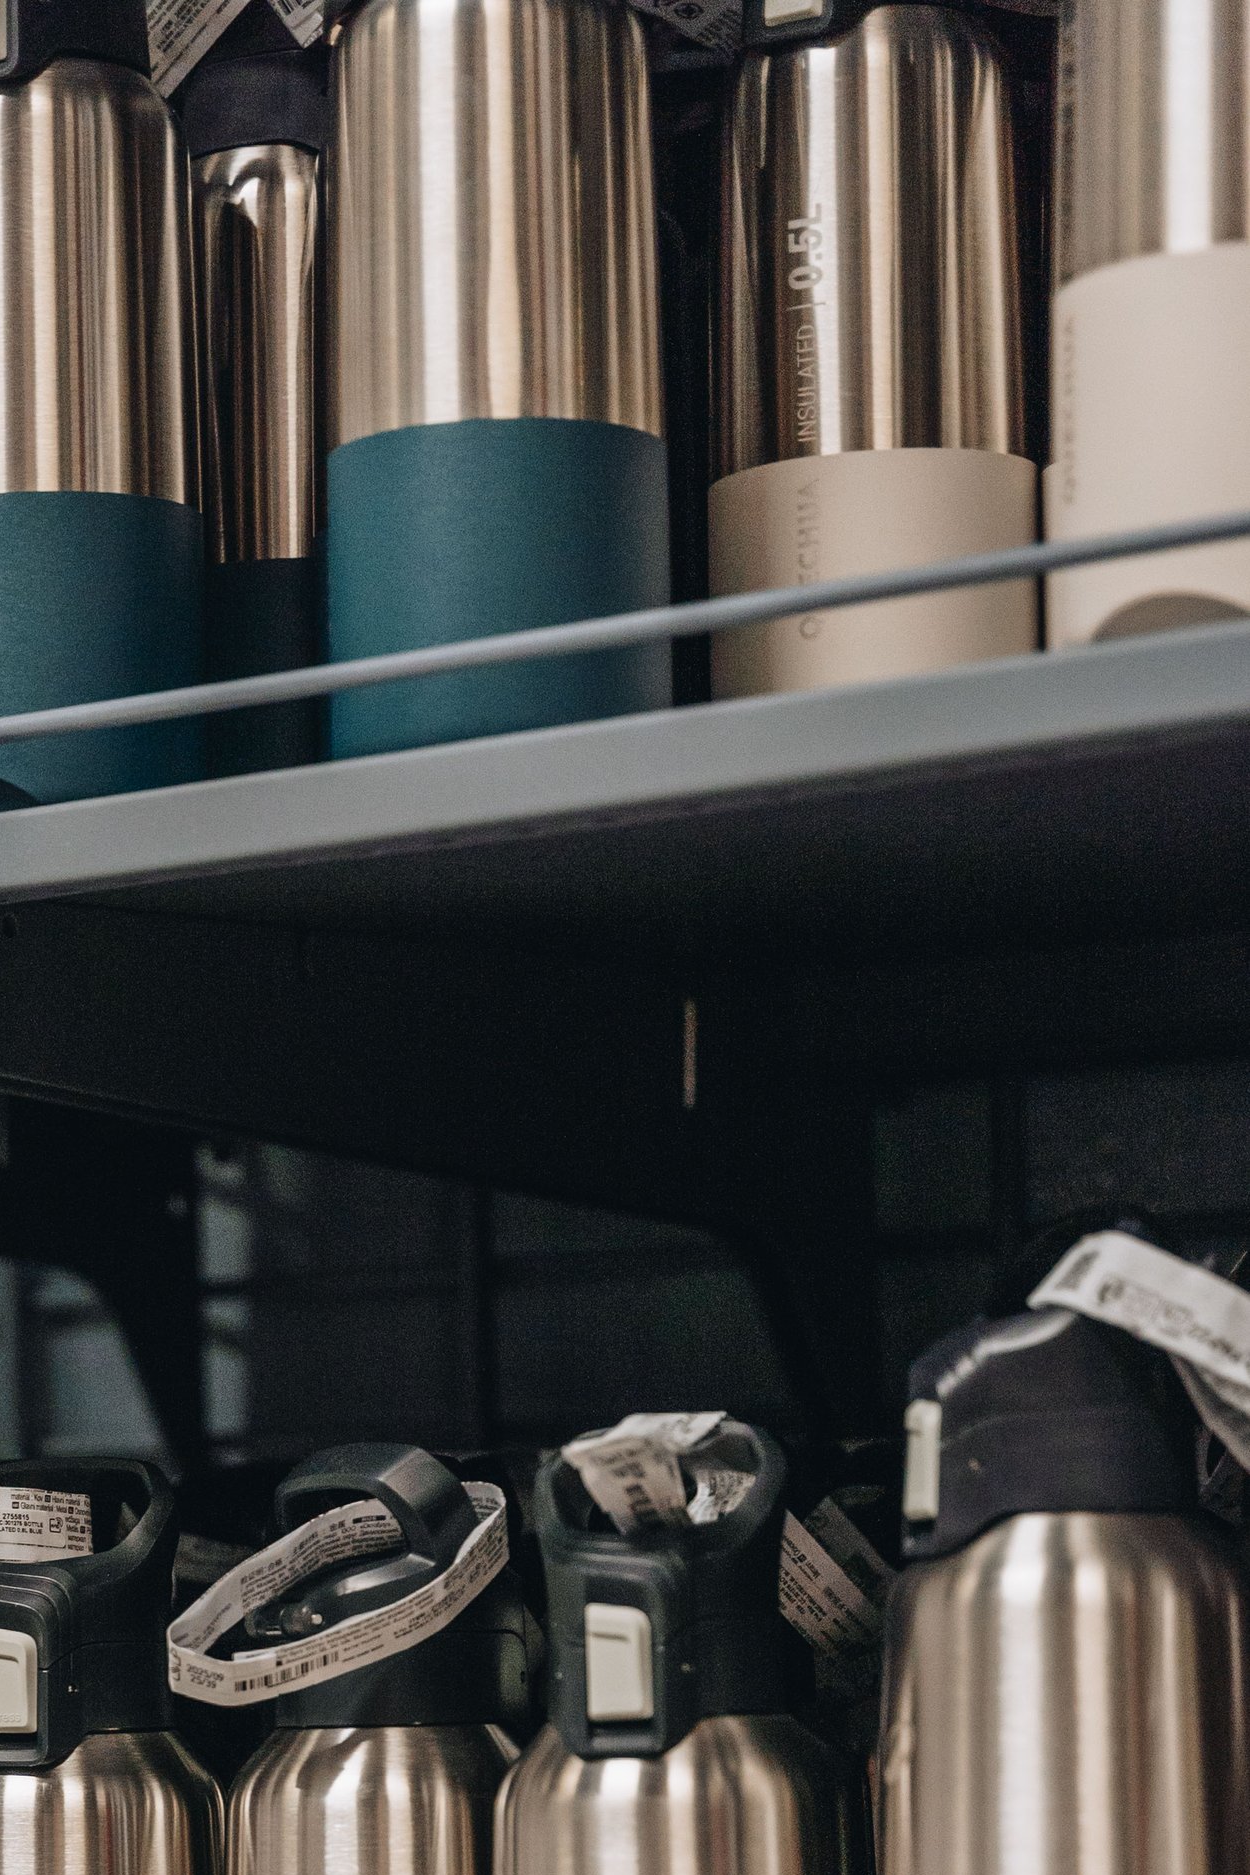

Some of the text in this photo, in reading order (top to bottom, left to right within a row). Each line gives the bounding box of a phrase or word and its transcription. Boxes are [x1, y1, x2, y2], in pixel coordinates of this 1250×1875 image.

[787, 202, 823, 290] 0.5L
[796, 324, 819, 444] INSULATED
[186, 1663, 225, 1682] 2025/09
[190, 1675, 217, 1689] 25/39
